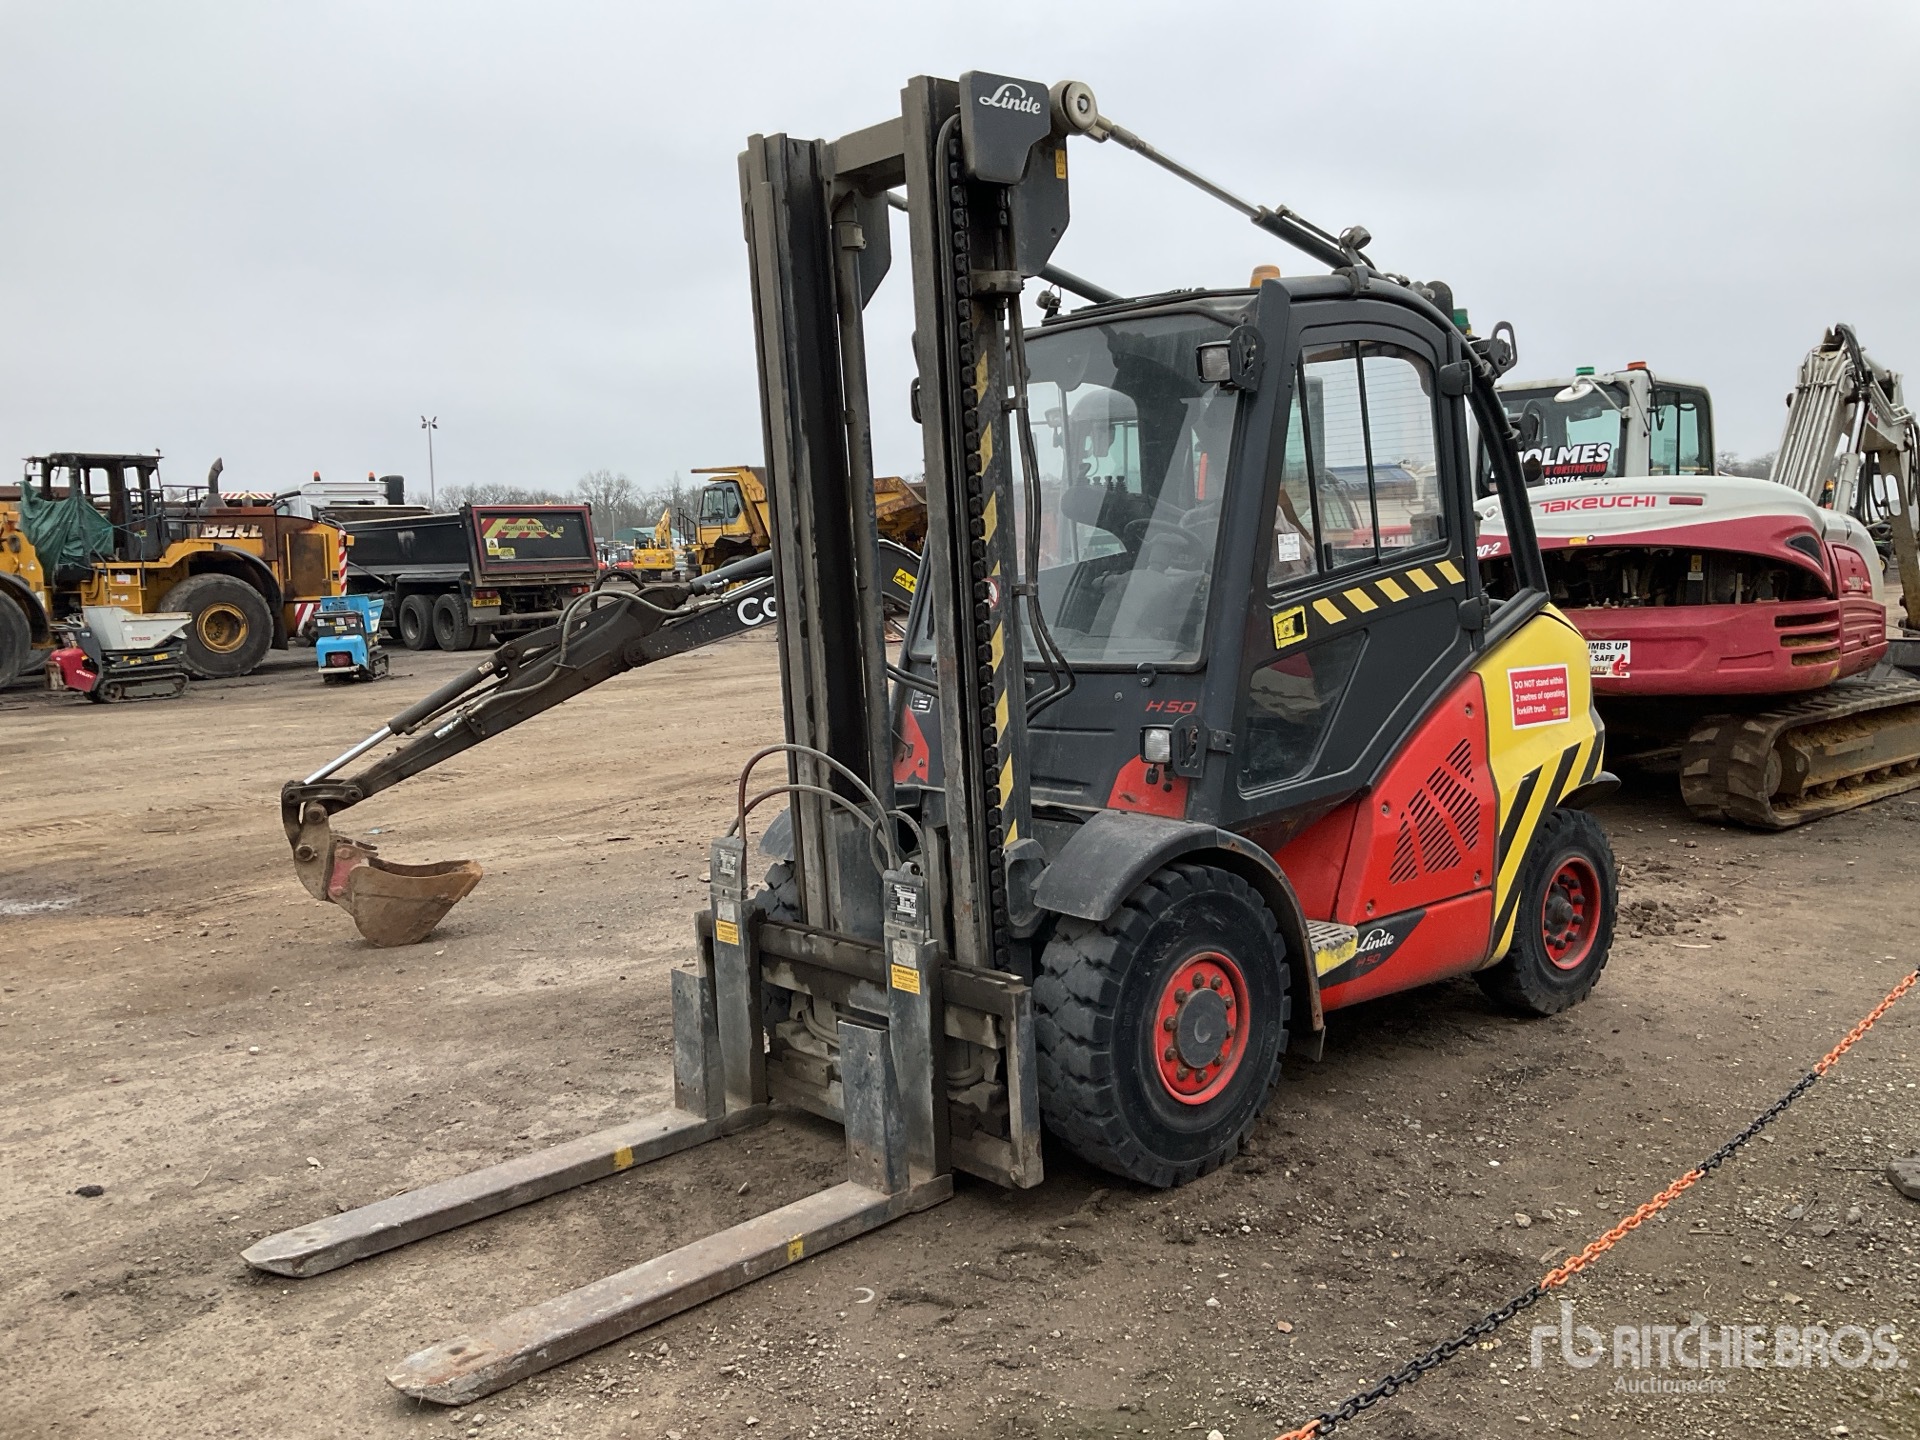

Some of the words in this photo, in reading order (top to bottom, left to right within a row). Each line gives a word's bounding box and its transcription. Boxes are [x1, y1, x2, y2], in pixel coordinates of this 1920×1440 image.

[979, 83, 1041, 115] Linde
[1553, 463, 1607, 474] CONSTRUCTION
[1539, 496, 1657, 513] TAKEUCHI
[200, 524, 263, 538] BELL
[1614, 642, 1628, 650] UP
[1594, 654, 1615, 662] SAFE
[1514, 680, 1523, 690] DO
[1523, 679, 1535, 688] NOT
[1535, 677, 1549, 687] stand
[1550, 676, 1564, 685] within
[1515, 694, 1520, 702] 2
[1520, 693, 1537, 702] metres
[1538, 691, 1543, 700] of
[1543, 689, 1566, 700] operating
[1516, 705, 1533, 715] forklift
[1533, 704, 1547, 713] truck
[1356, 928, 1394, 952] Linde
